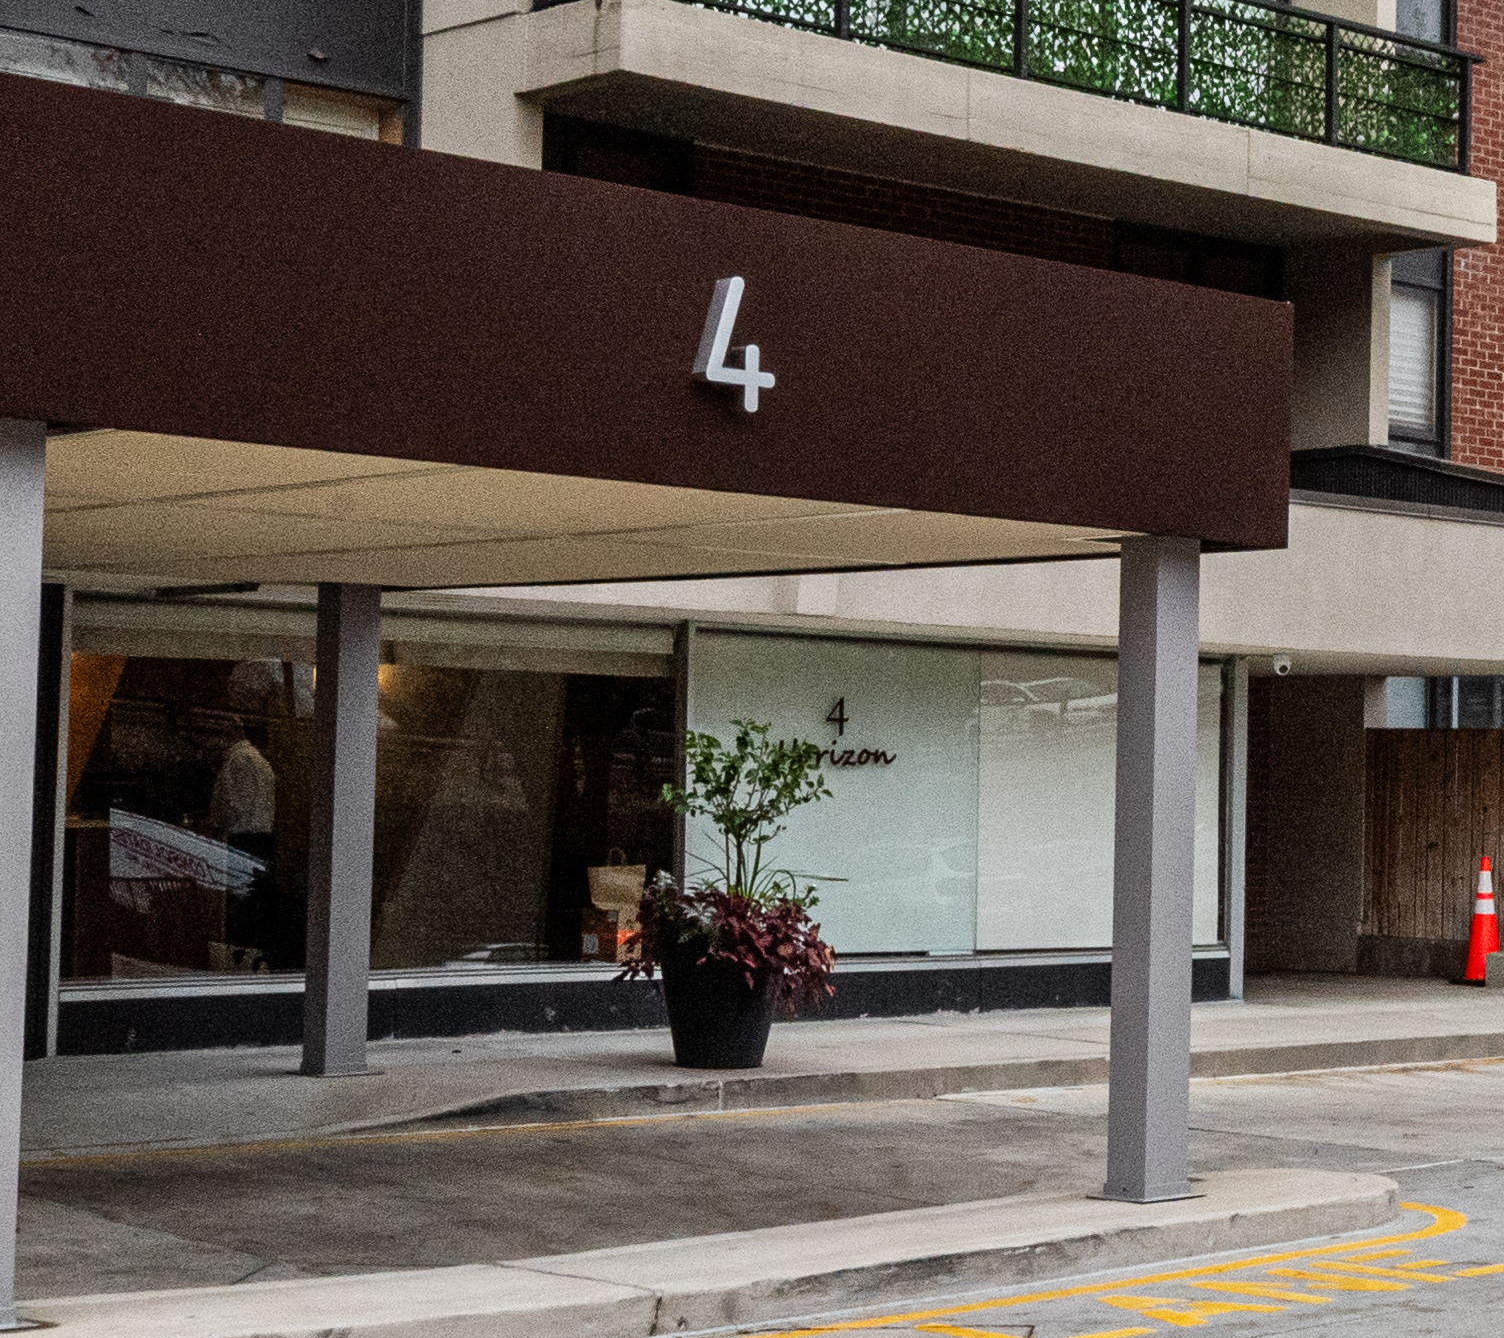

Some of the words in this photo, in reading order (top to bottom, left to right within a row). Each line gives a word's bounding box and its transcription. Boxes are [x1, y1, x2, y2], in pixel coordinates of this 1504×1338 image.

[693, 275, 776, 413] 4
[826, 696, 850, 737] 4
[777, 737, 897, 767] rizon
